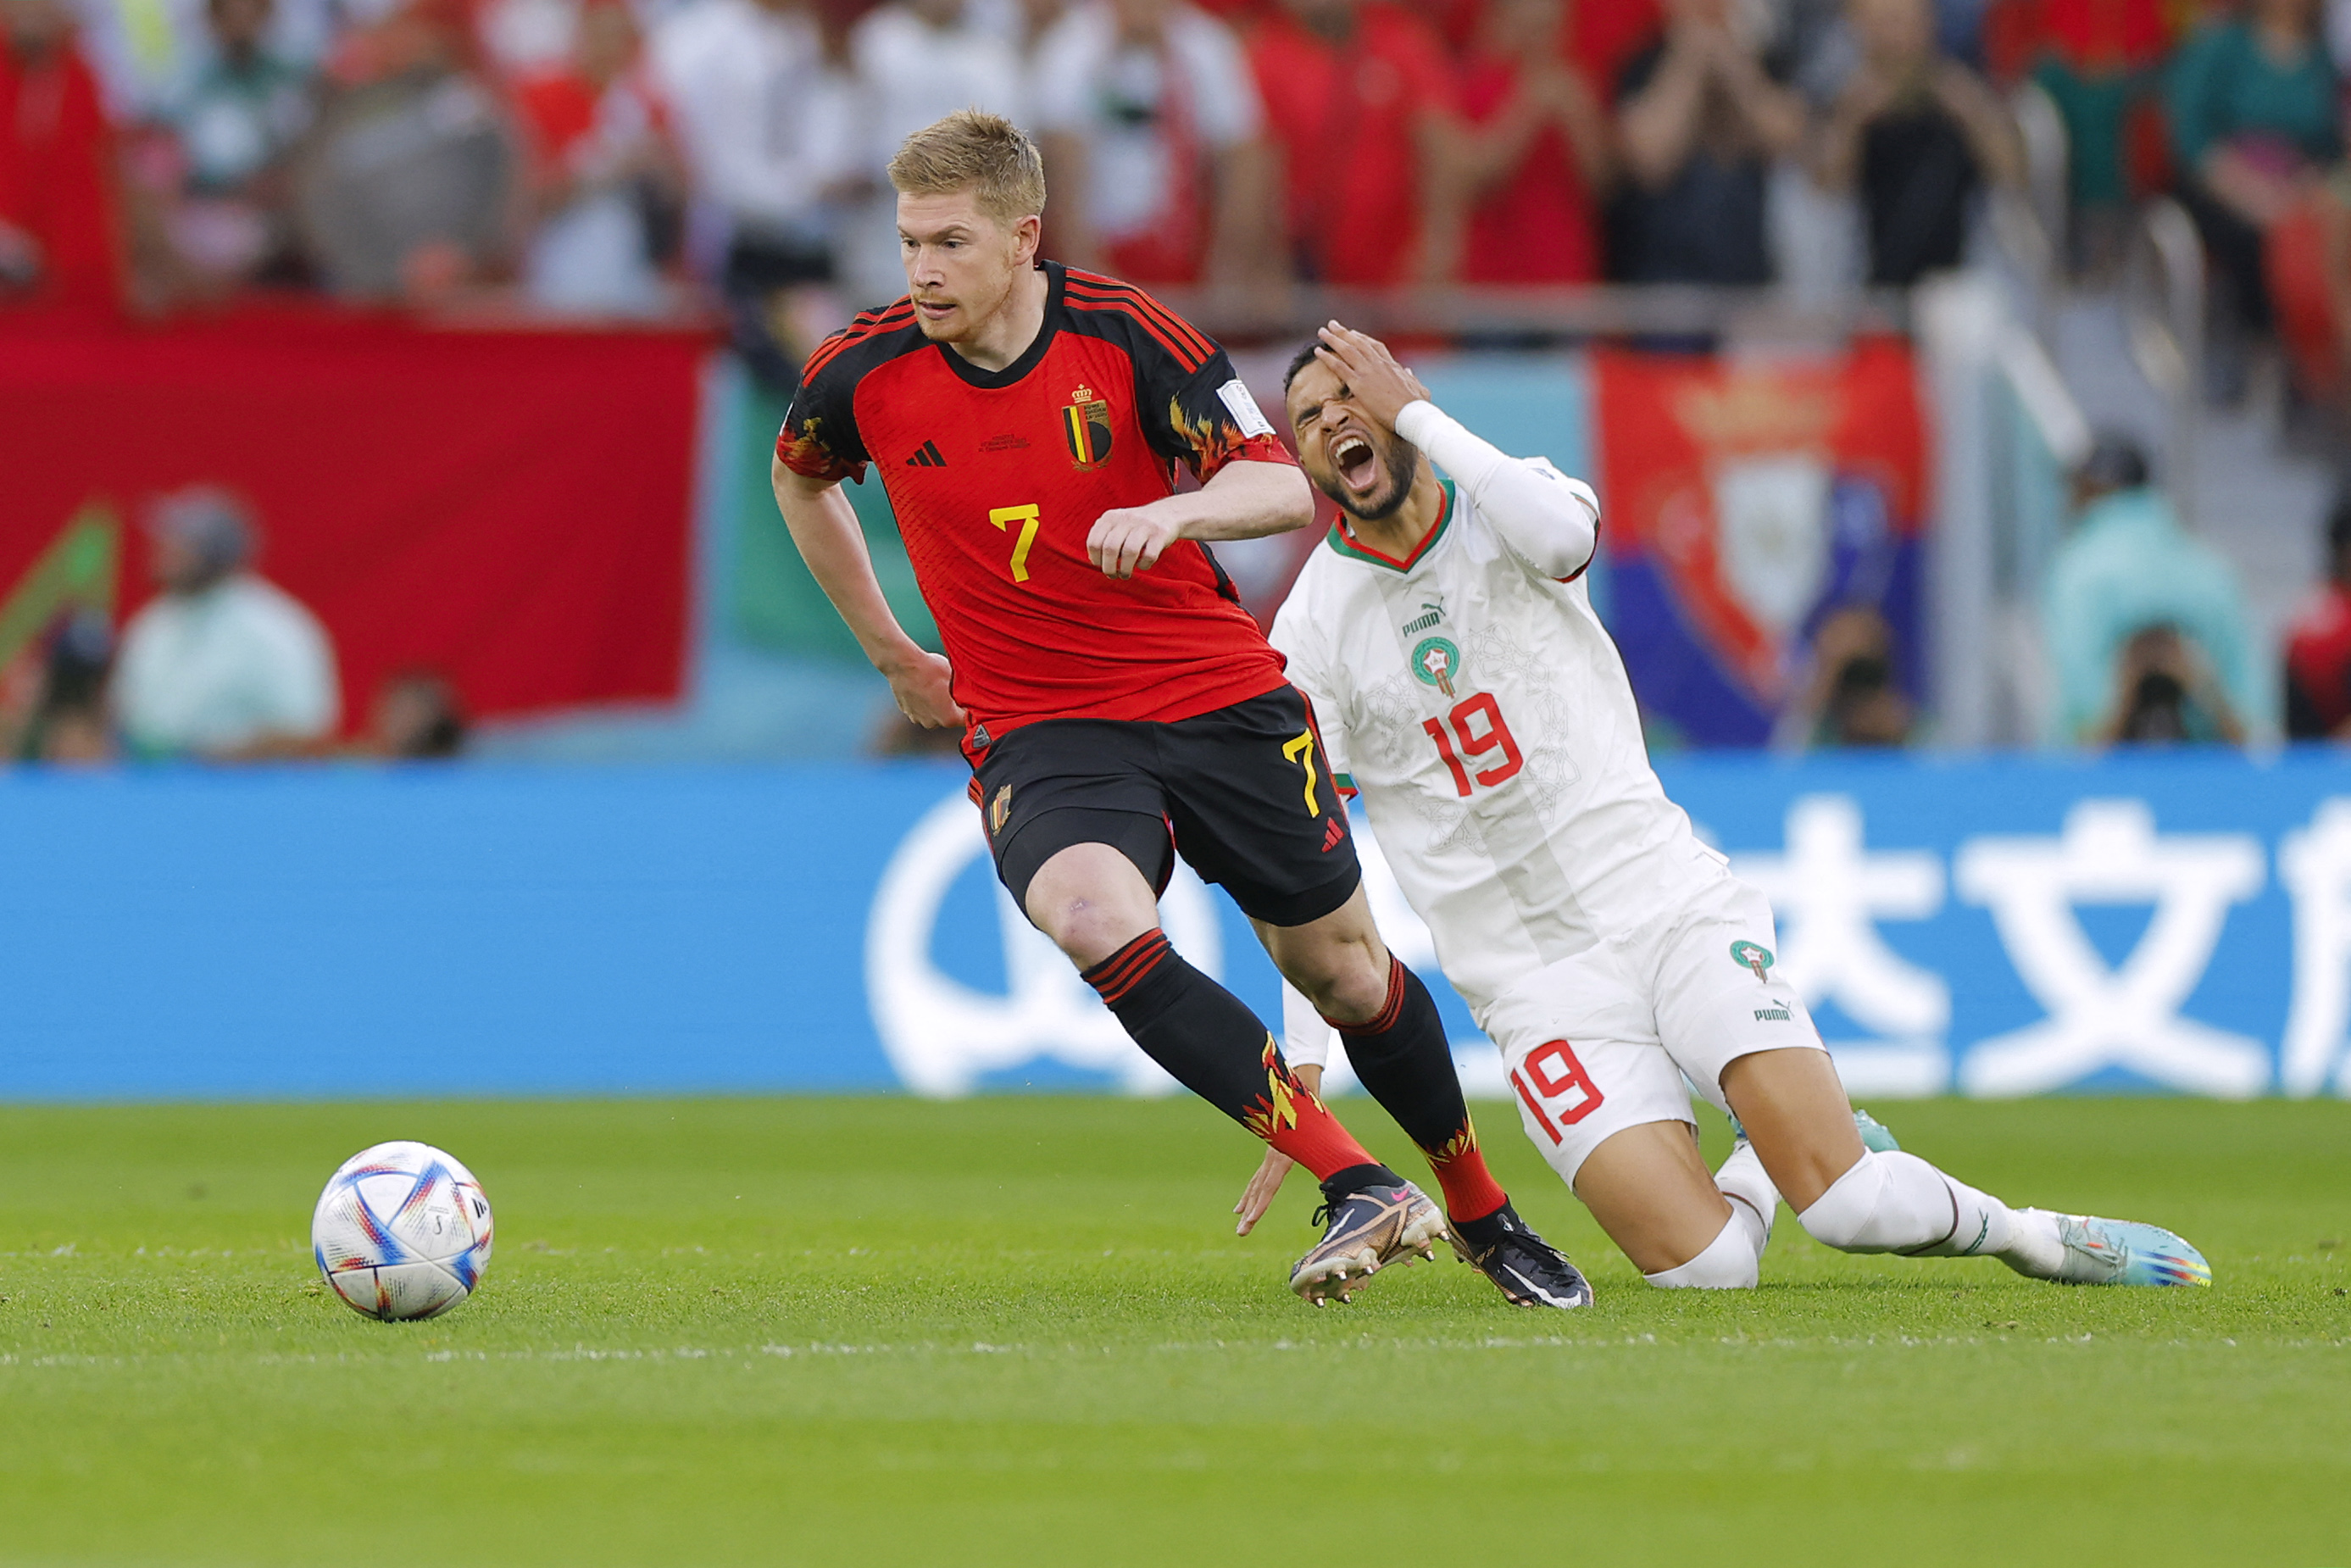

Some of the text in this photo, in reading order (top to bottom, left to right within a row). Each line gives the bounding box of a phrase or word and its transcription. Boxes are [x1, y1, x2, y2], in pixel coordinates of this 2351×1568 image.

[988, 503, 1040, 583] 7
[1402, 612, 1441, 637] PUMA
[1281, 727, 1320, 819] 7
[1421, 692, 1524, 798] 19
[1754, 1009, 1791, 1022] PUMA
[1509, 1038, 1605, 1148] 19
